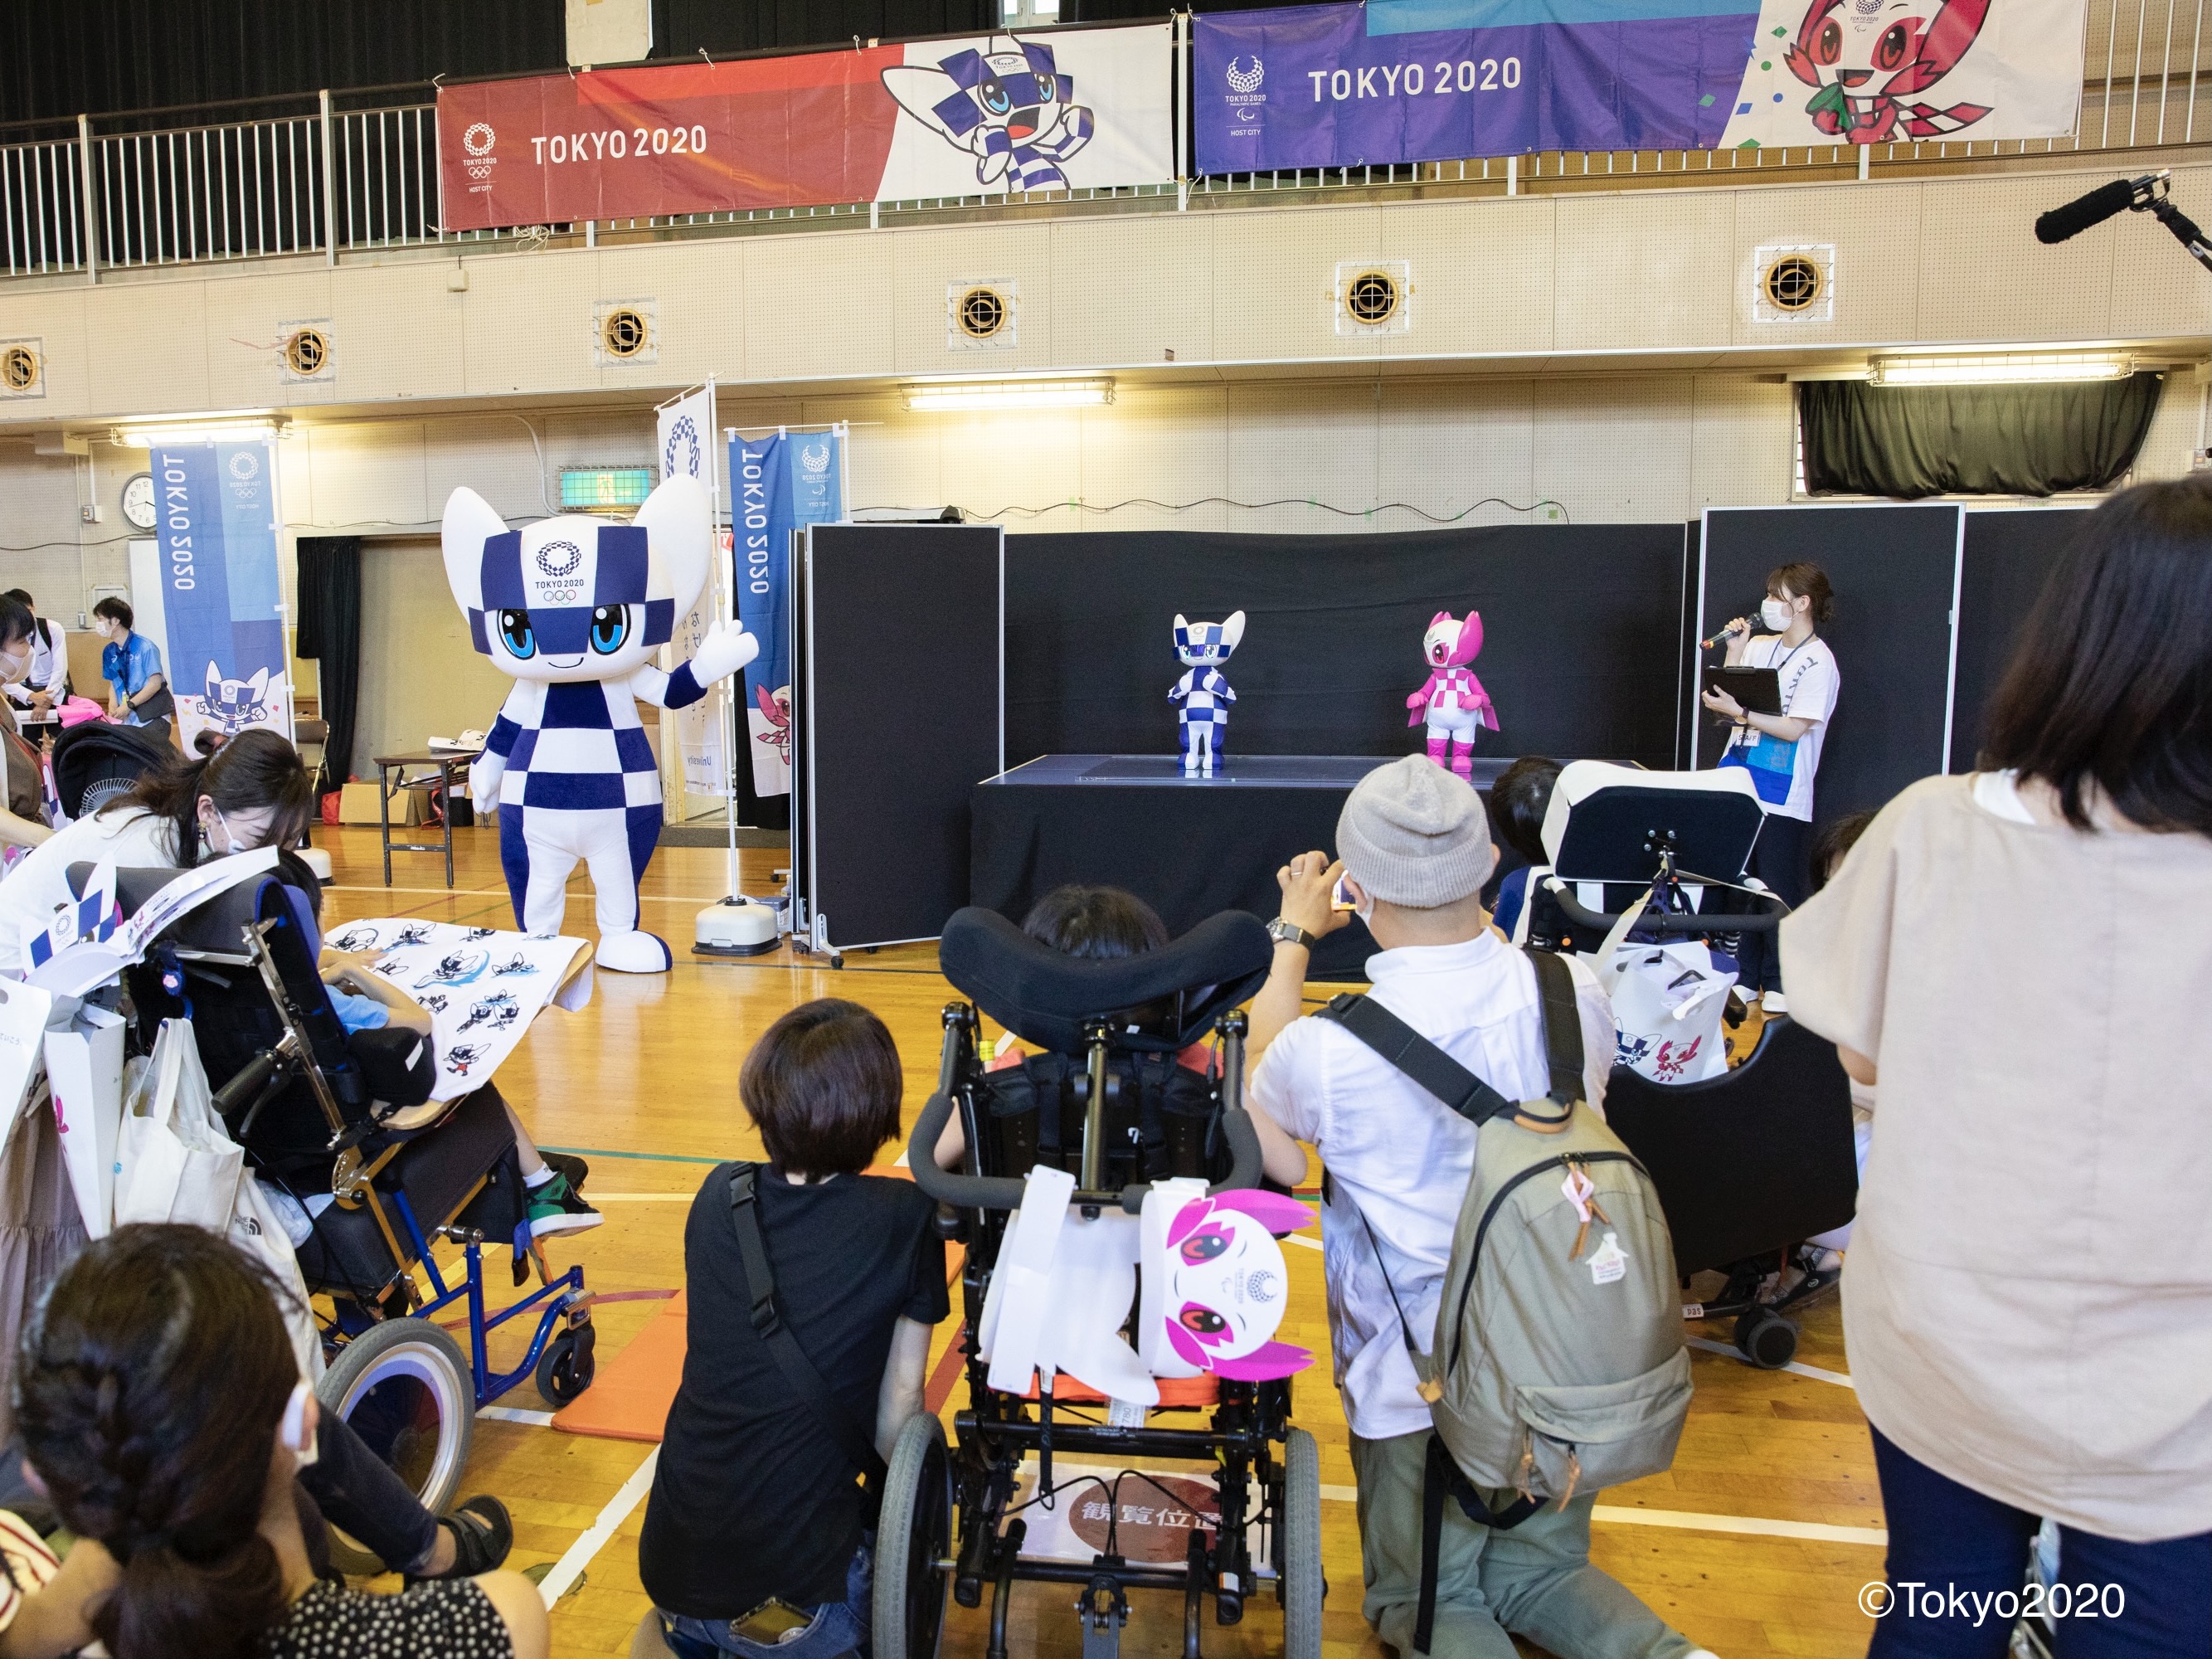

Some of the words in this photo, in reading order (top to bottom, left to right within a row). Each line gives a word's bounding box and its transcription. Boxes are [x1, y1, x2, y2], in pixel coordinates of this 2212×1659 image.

[1308, 64, 1424, 102] TOKYO
[1434, 56, 1521, 94] 2020
[531, 129, 626, 164] TOKYO
[633, 124, 707, 157] 2020
[535, 580, 562, 589] TOKYO
[564, 578, 584, 587] 2020
